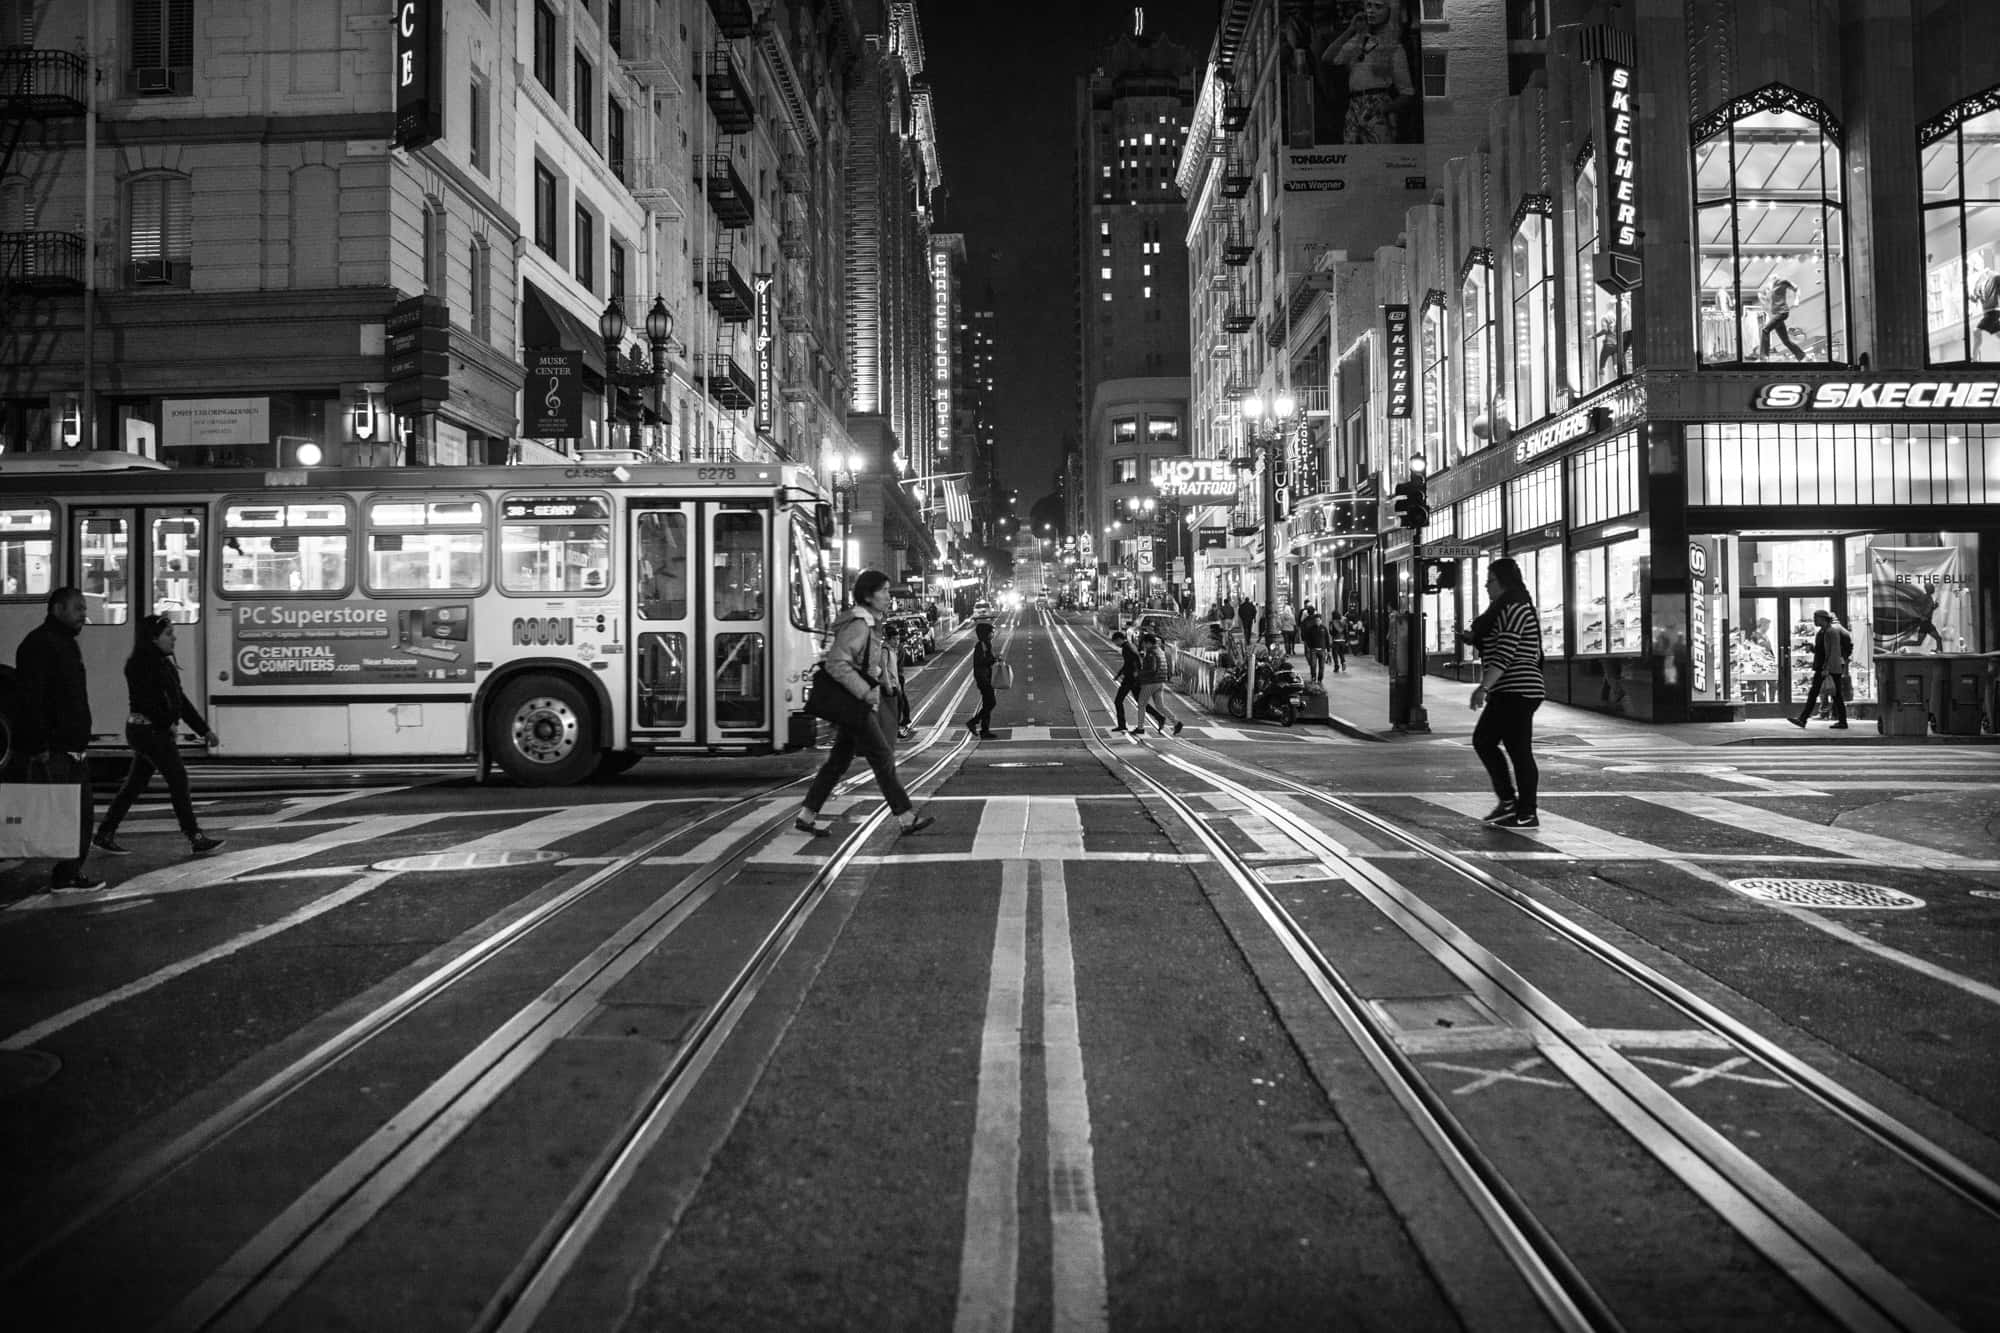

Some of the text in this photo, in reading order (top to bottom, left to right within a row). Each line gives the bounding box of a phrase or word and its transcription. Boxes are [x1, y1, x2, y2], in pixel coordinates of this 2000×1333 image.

[1611, 68, 1635, 246] SKECHERS
[1289, 180, 1343, 192] Van Wagner
[755, 279, 773, 337] VILLA
[535, 367, 572, 376] CENTER
[539, 356, 569, 366] MUSIC
[1391, 323, 1407, 416] SKECHERS
[756, 336, 772, 422] FLORENCE
[1813, 382, 2000, 408] SKECHE
[936, 387, 949, 452] HOTEL
[1526, 413, 1588, 458] SKECHERS
[1160, 460, 1237, 481] HOTEL
[1300, 422, 1310, 496] COCKTAILS
[697, 468, 736, 480] 6278
[1896, 574, 1973, 585] BE THE BLU
[239, 605, 388, 627] PC Superstore
[1692, 578, 1707, 693] SKECHERS
[260, 646, 335, 658] CENTRAL
[260, 659, 360, 673] COMPUTERS.com
